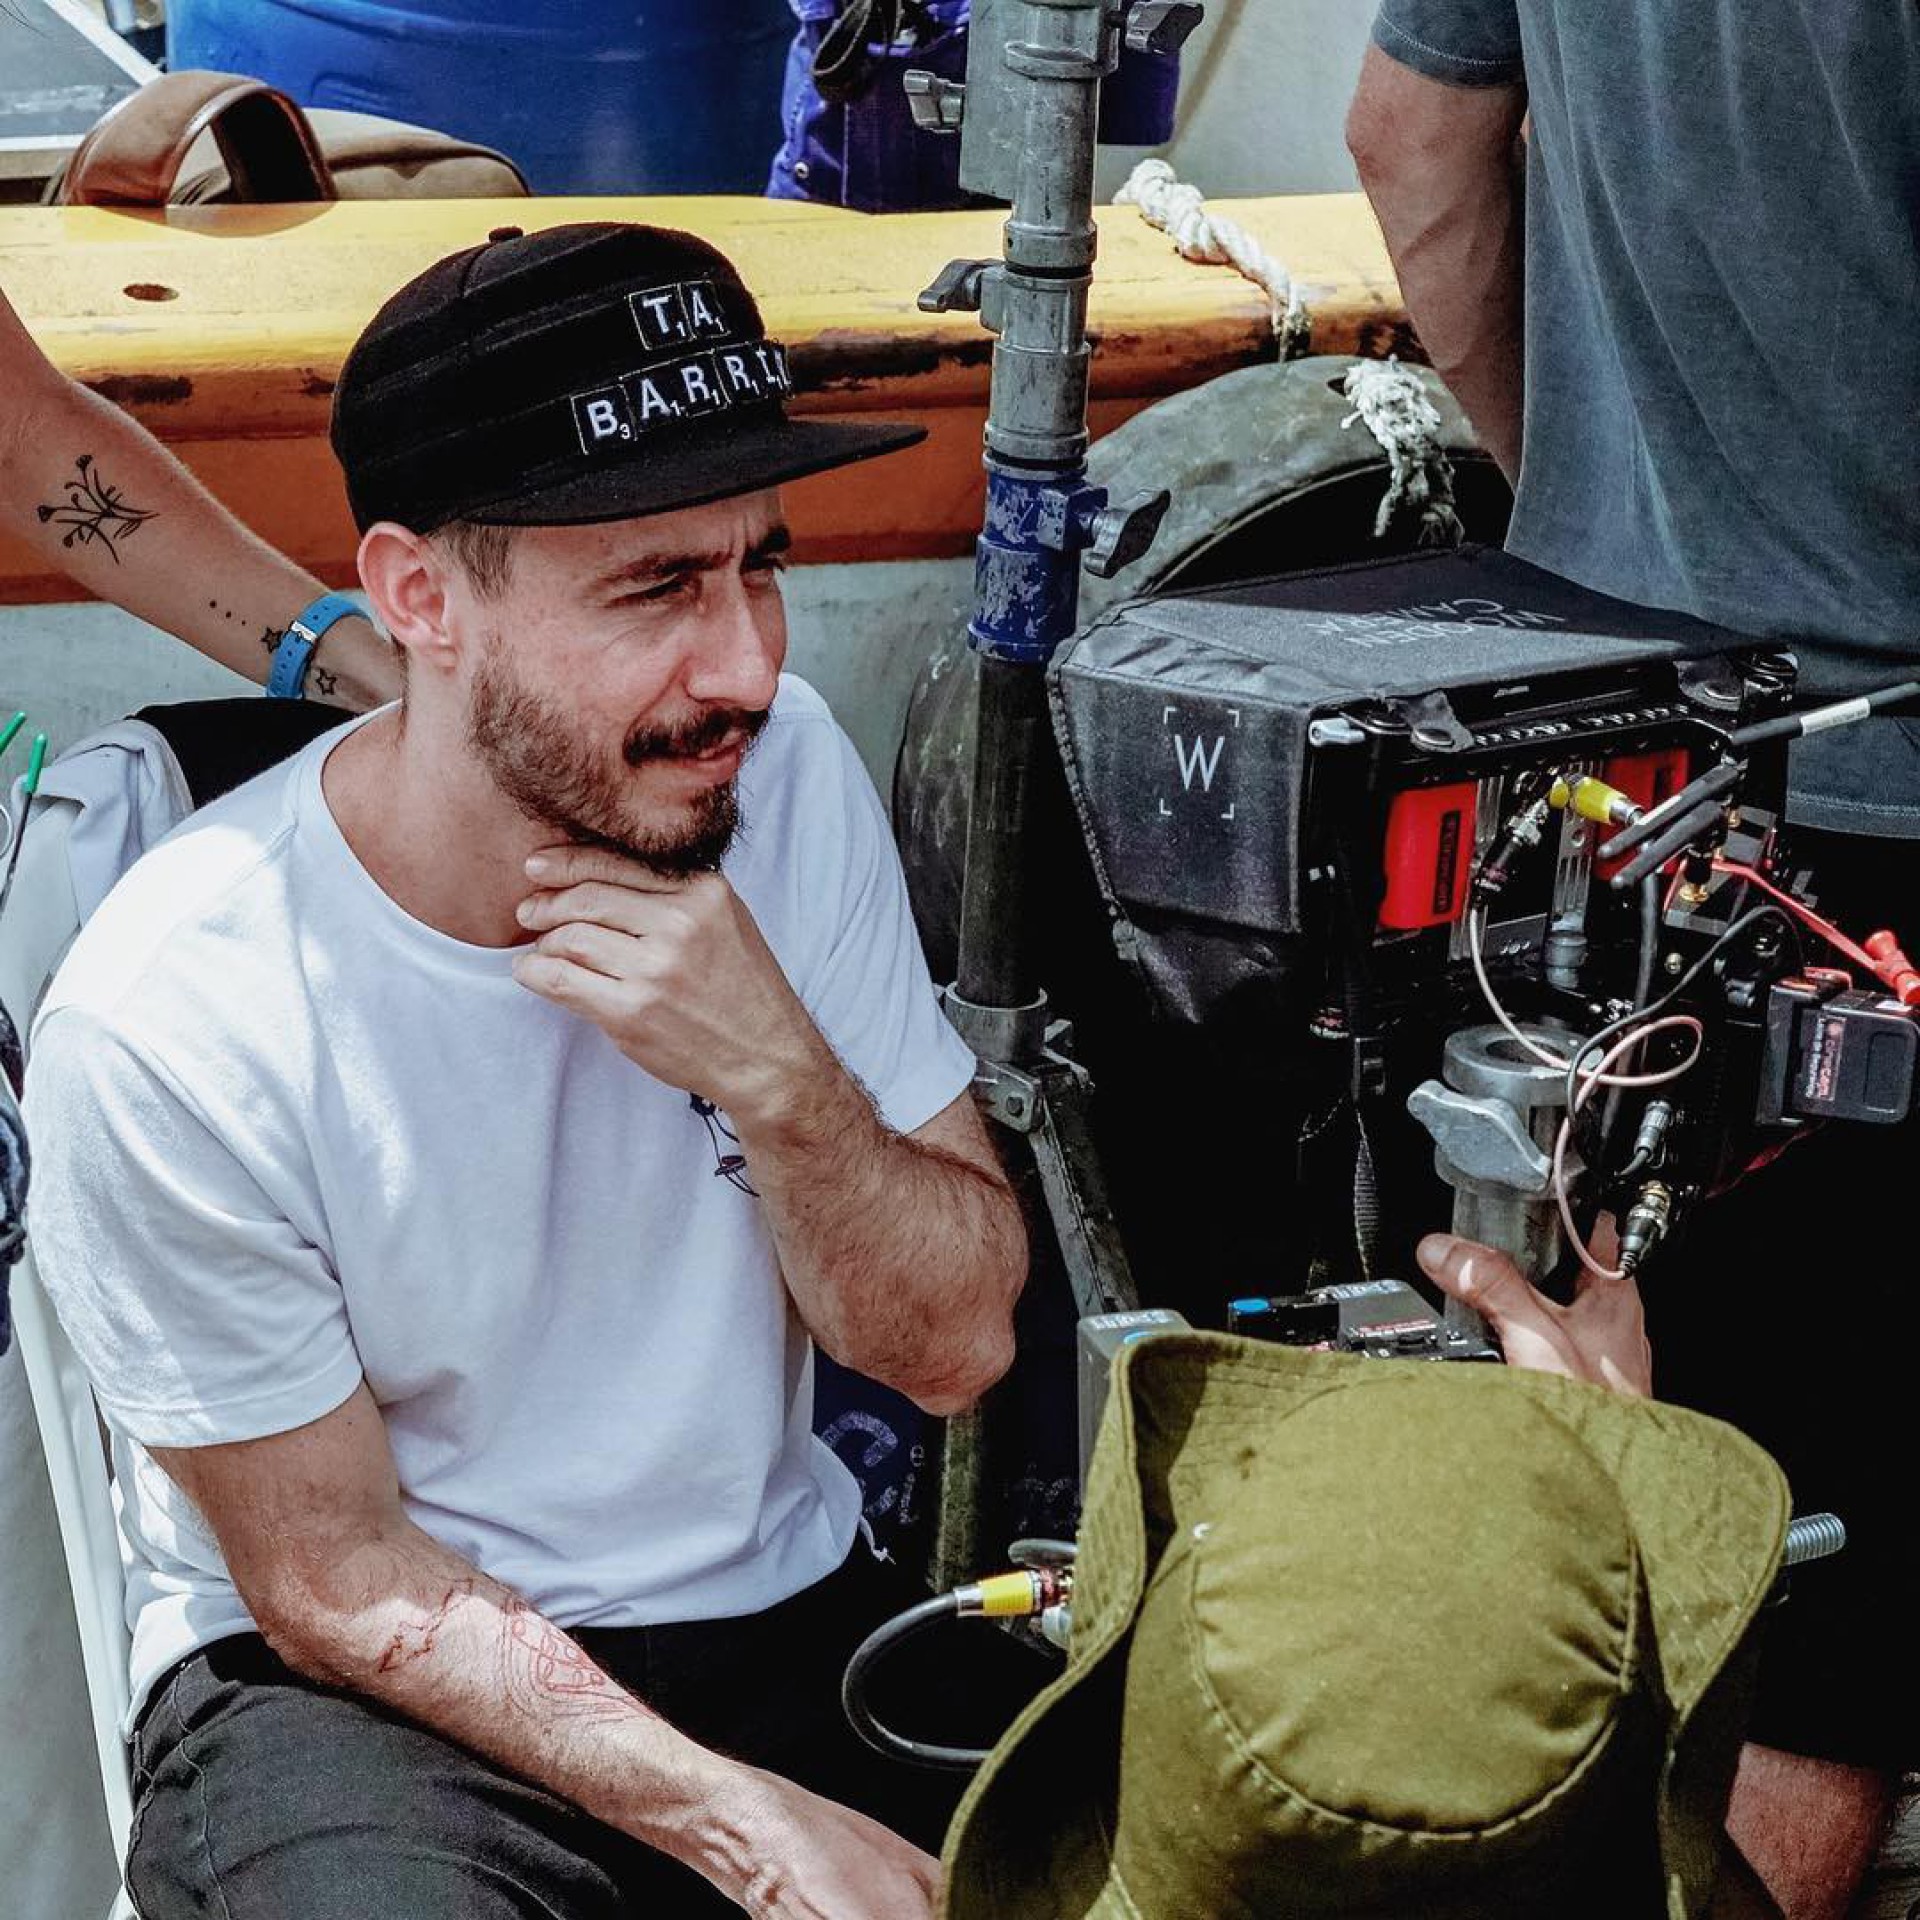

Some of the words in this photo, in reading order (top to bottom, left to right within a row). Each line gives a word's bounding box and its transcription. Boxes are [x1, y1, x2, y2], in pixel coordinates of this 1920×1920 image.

[1306, 598, 1505, 636] CAMERA
[1345, 609, 1566, 648] WOODEN
[1174, 735, 1226, 792] W
